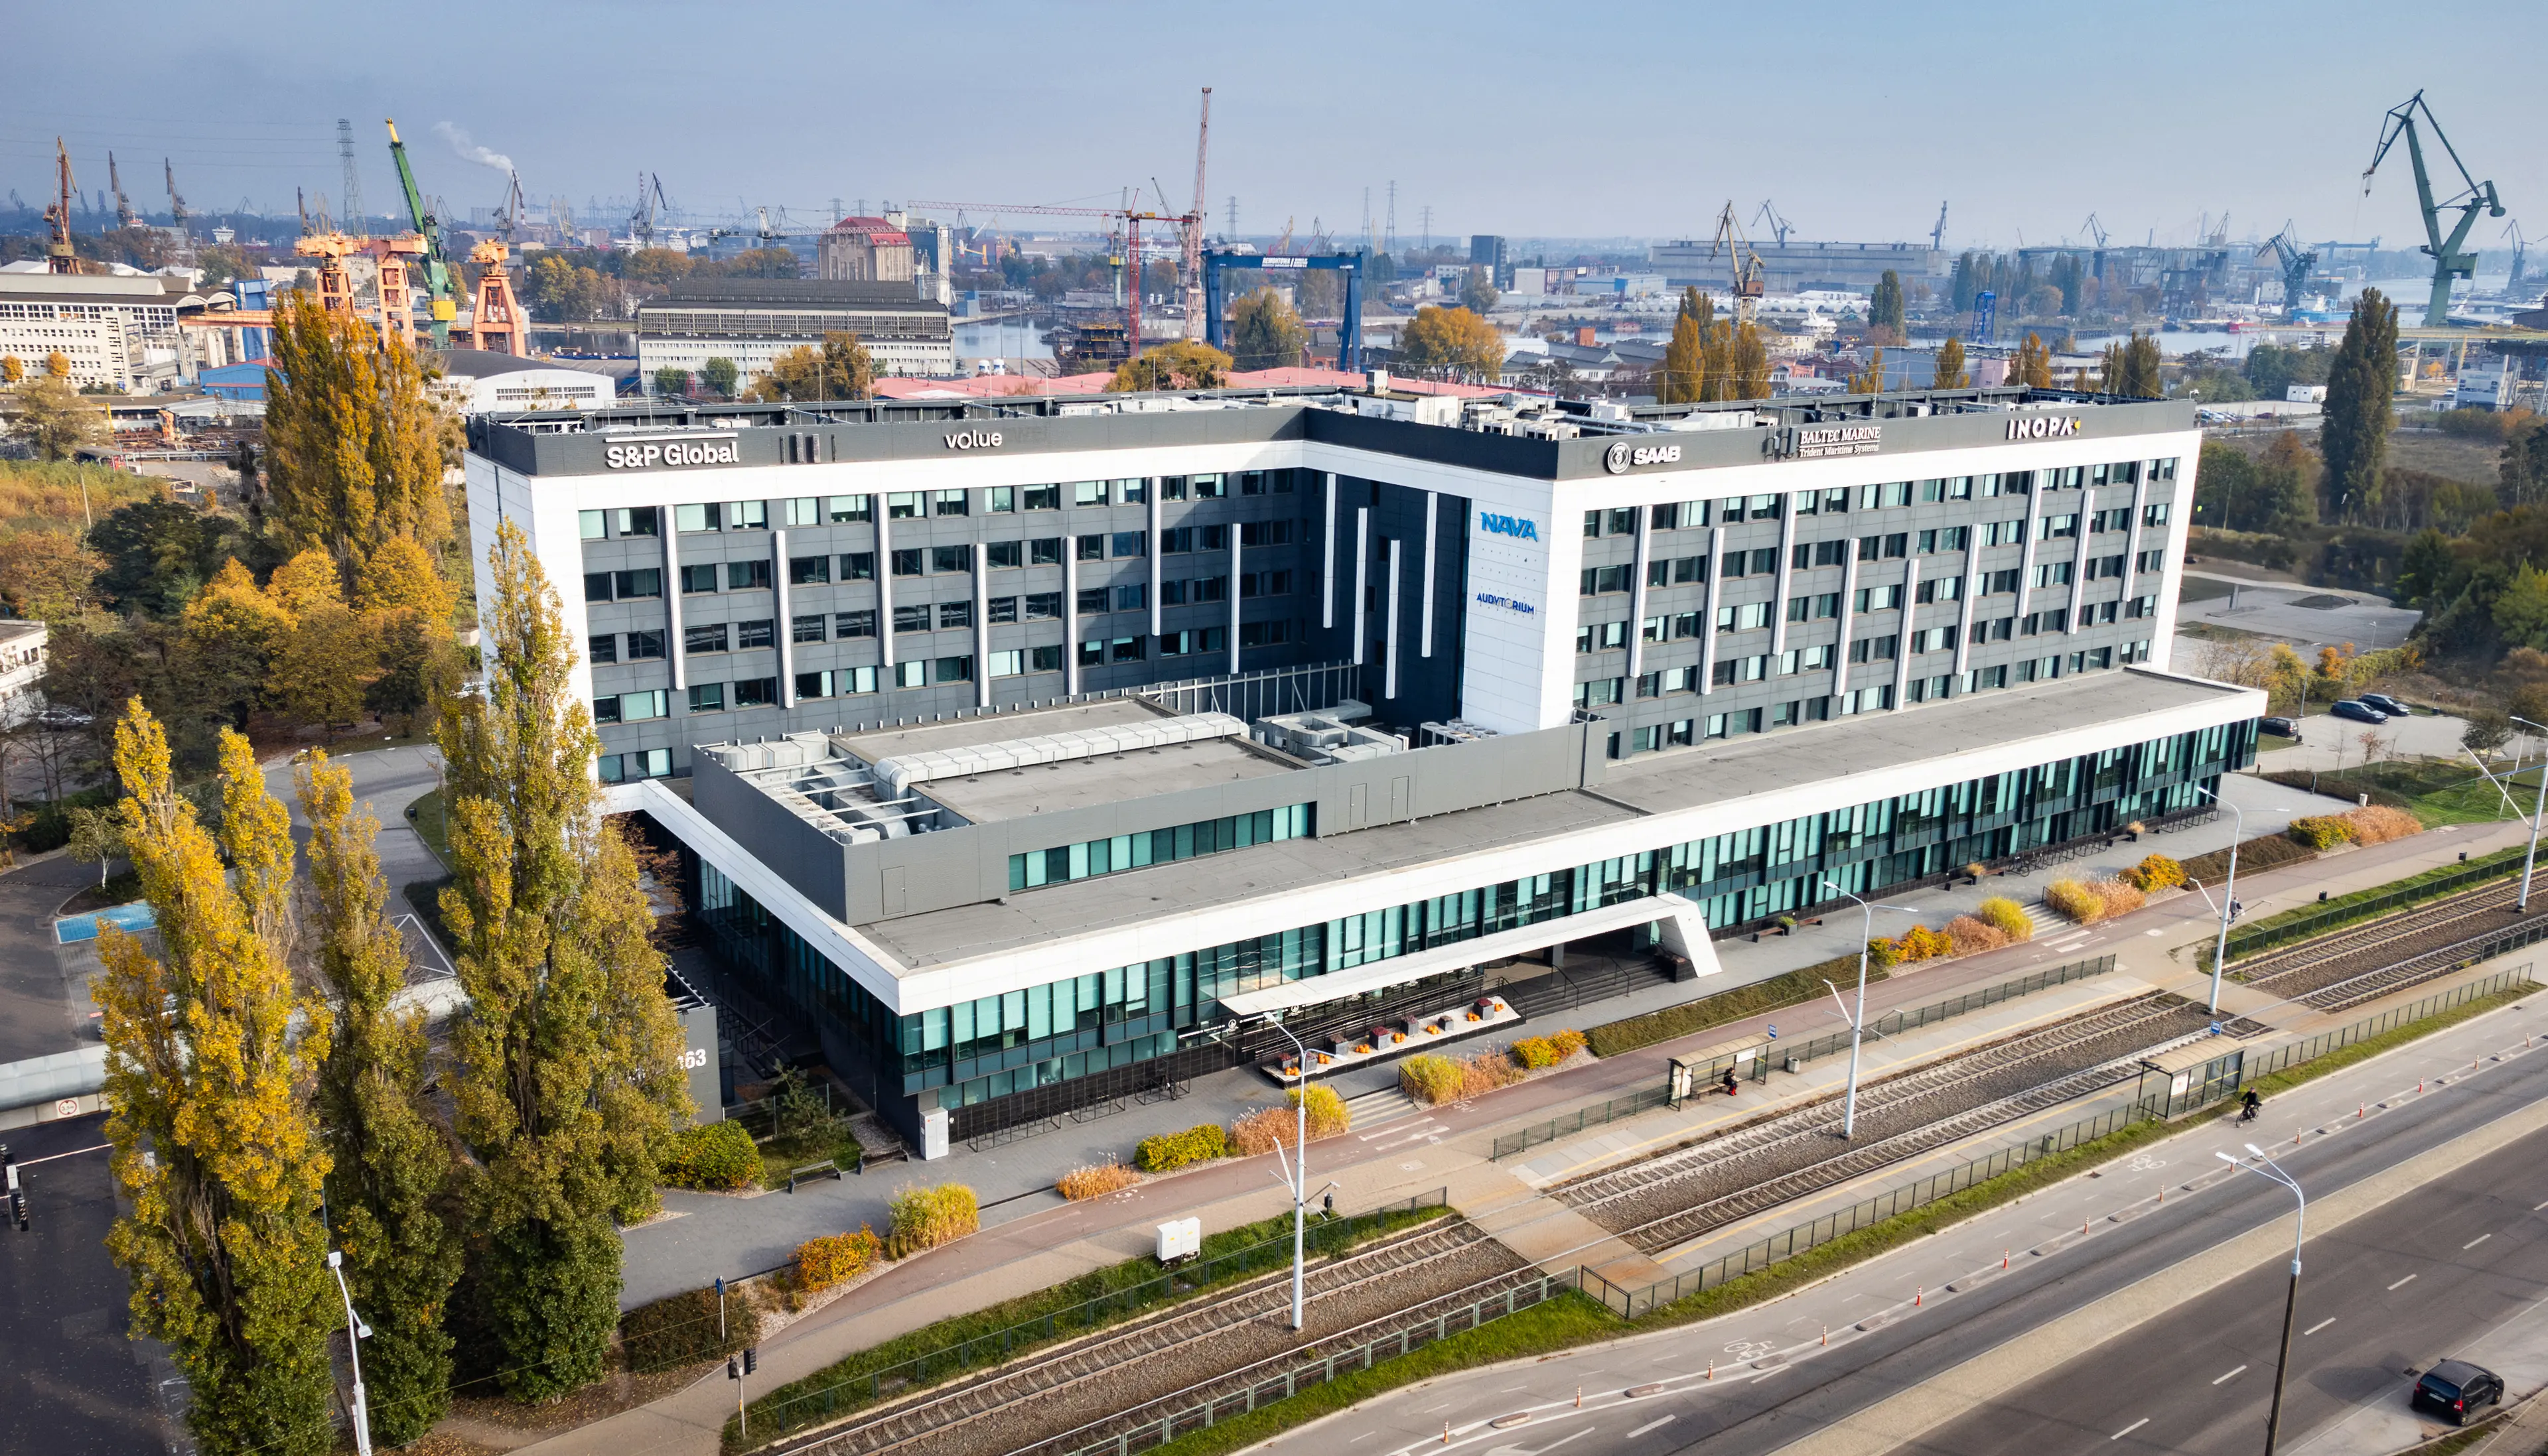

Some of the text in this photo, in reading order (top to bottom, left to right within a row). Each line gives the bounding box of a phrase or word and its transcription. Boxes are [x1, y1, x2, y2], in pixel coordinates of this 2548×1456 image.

[945, 429, 1003, 449] volue
[1800, 427, 1882, 444] BALTEC MARINE
[606, 441, 739, 468] S&P Global
[1633, 446, 1681, 466] SAAB
[1799, 444, 1880, 458] Trident Maritime Systems
[1480, 512, 1538, 542] NAVA
[1476, 592, 1535, 615] AUDYTORIUM
